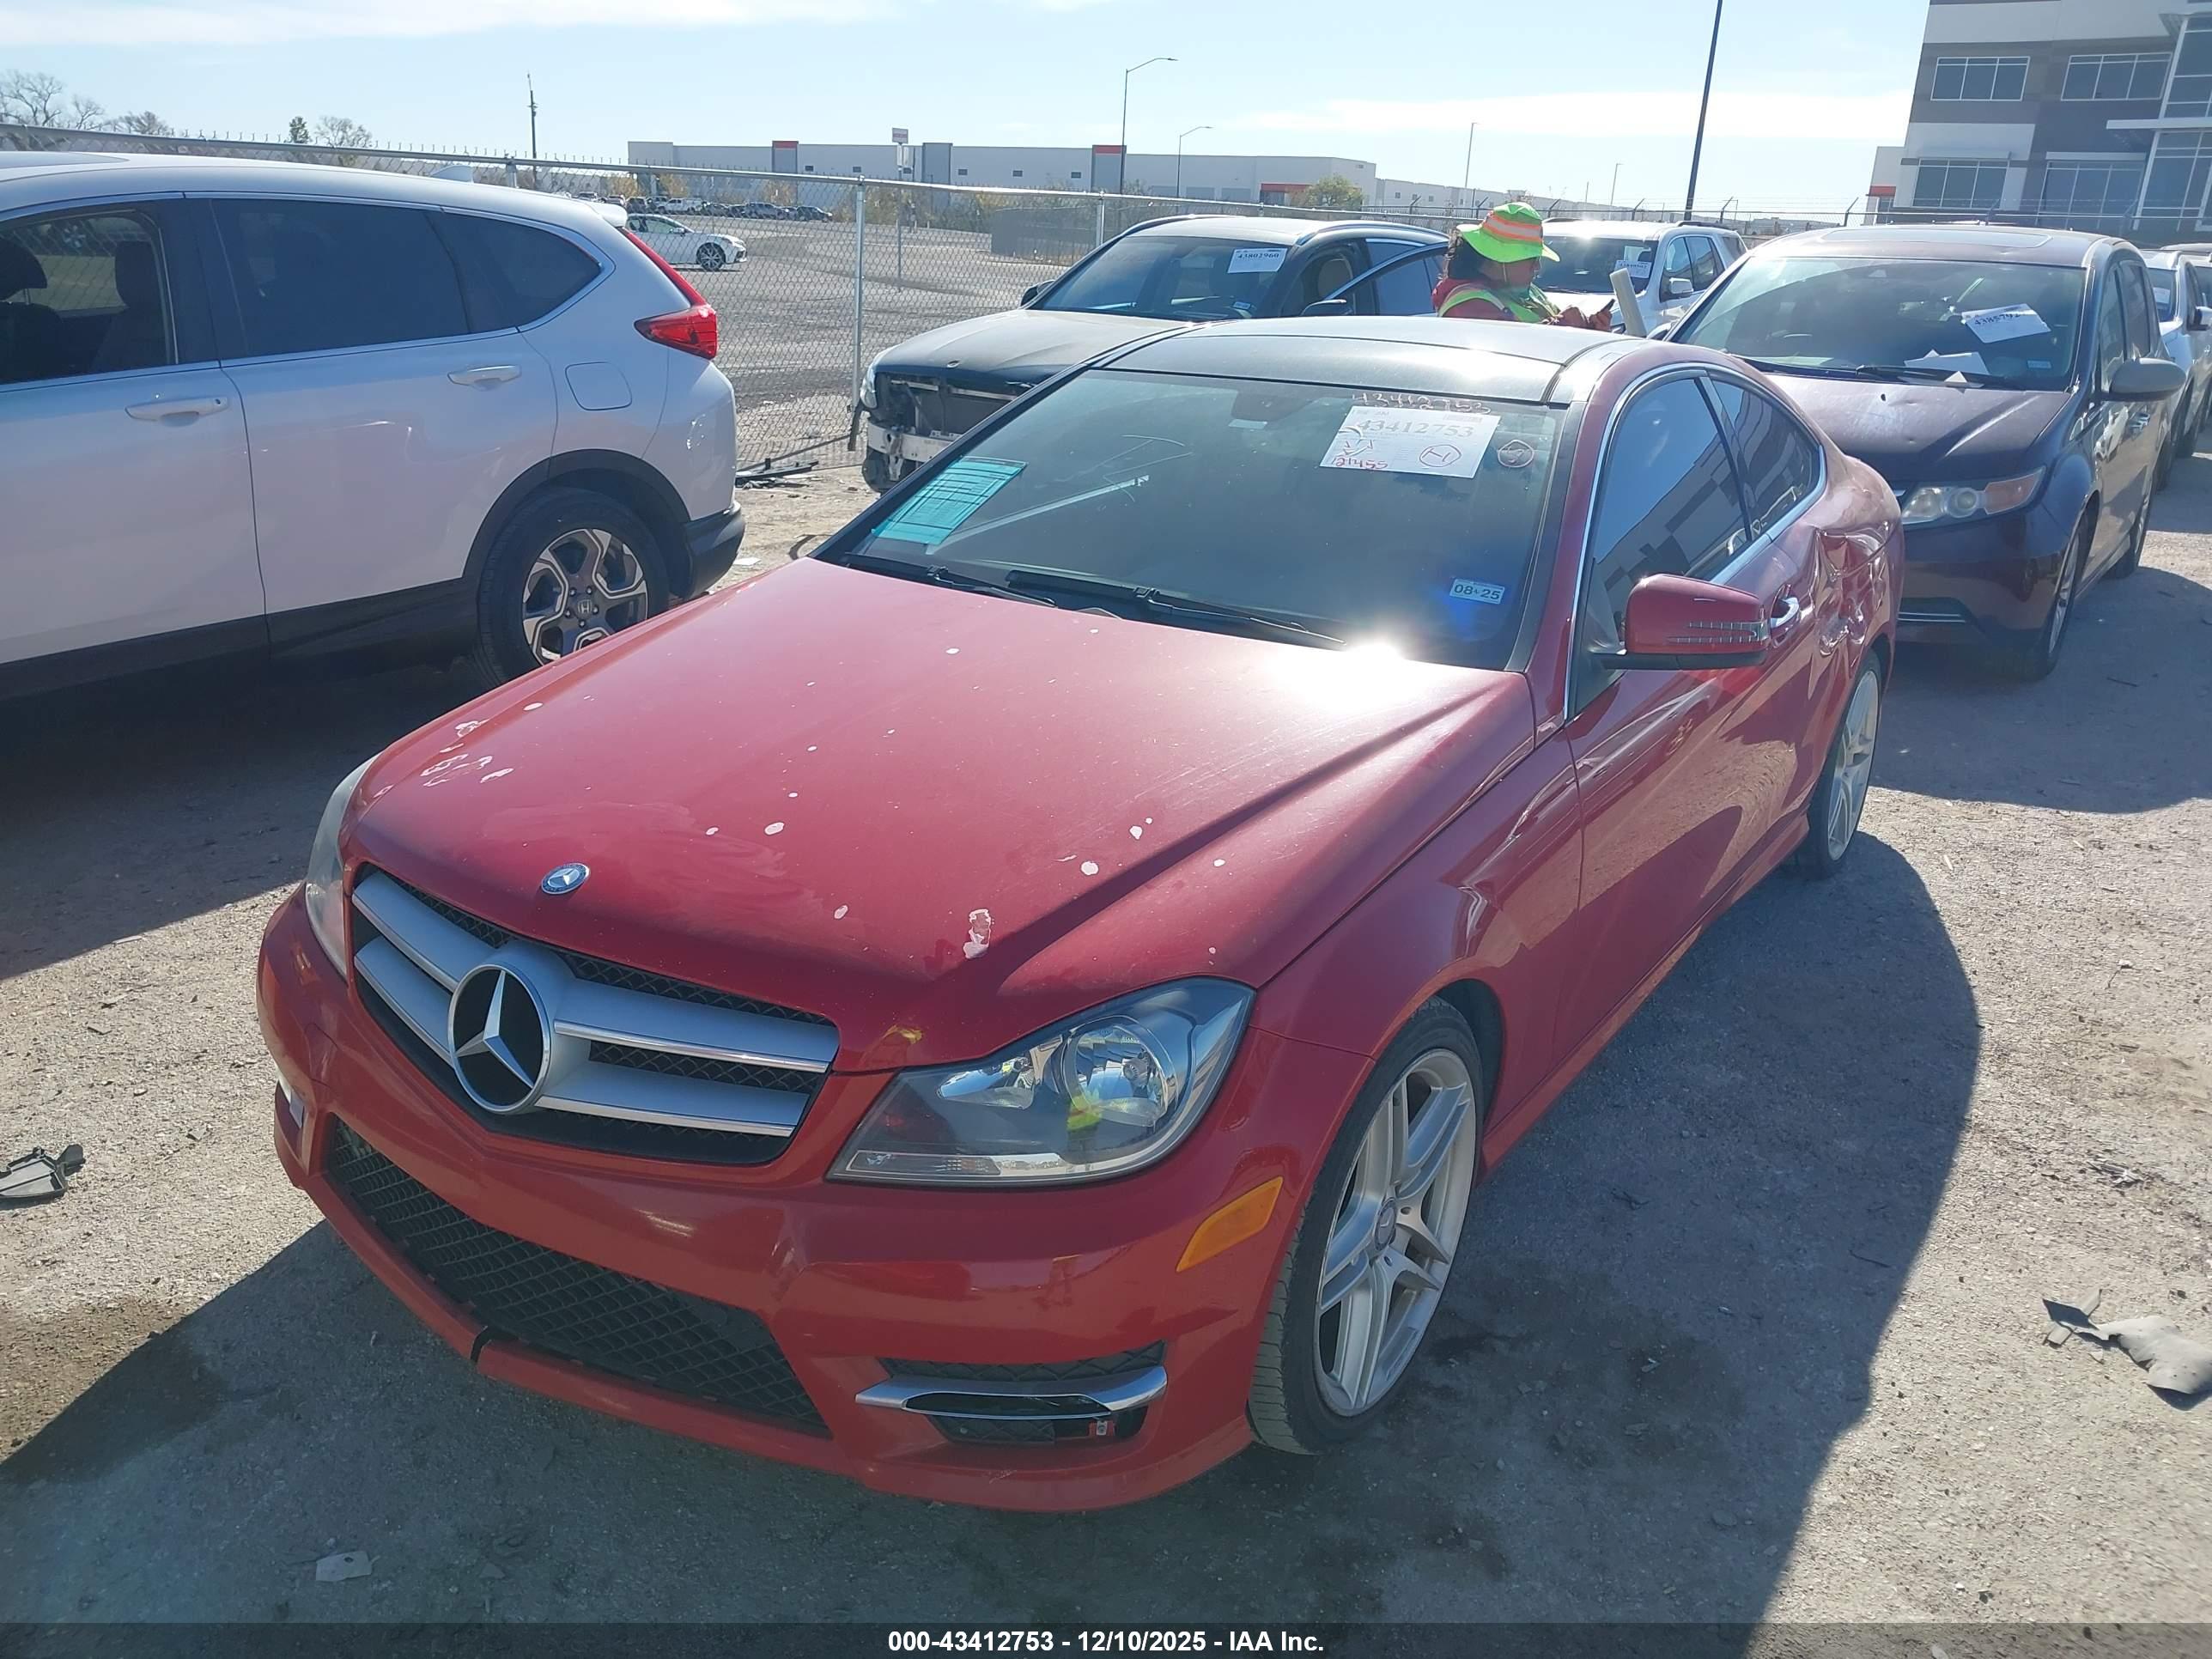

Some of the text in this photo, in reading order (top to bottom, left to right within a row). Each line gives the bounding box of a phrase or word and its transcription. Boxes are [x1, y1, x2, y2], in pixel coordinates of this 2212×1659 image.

[1352, 392, 1492, 415] 43412753
[1359, 419, 1474, 438] 43412753
[1480, 588, 1501, 600] 25
